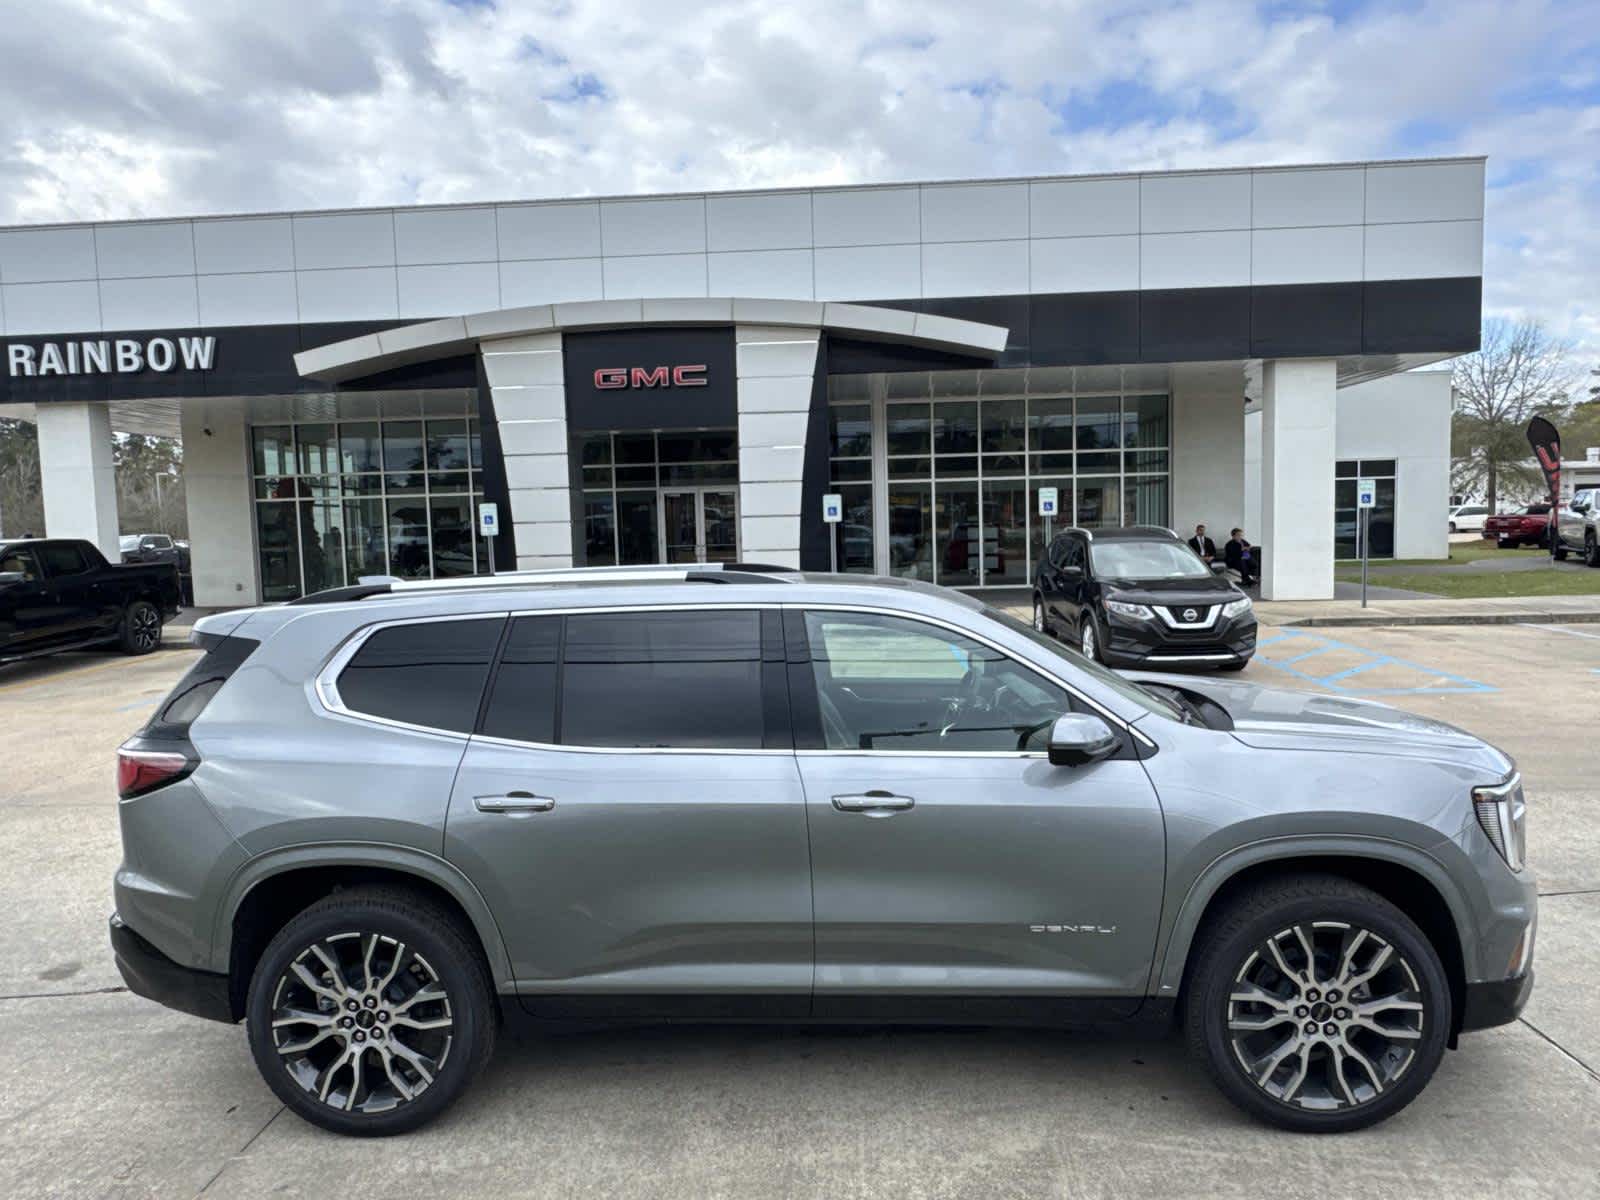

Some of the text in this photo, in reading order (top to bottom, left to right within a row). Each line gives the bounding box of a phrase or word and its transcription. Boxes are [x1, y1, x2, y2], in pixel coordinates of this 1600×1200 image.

[7, 336, 217, 377] RAINBOW
[593, 364, 708, 390] GMC
[1029, 924, 1117, 934] DENALI
